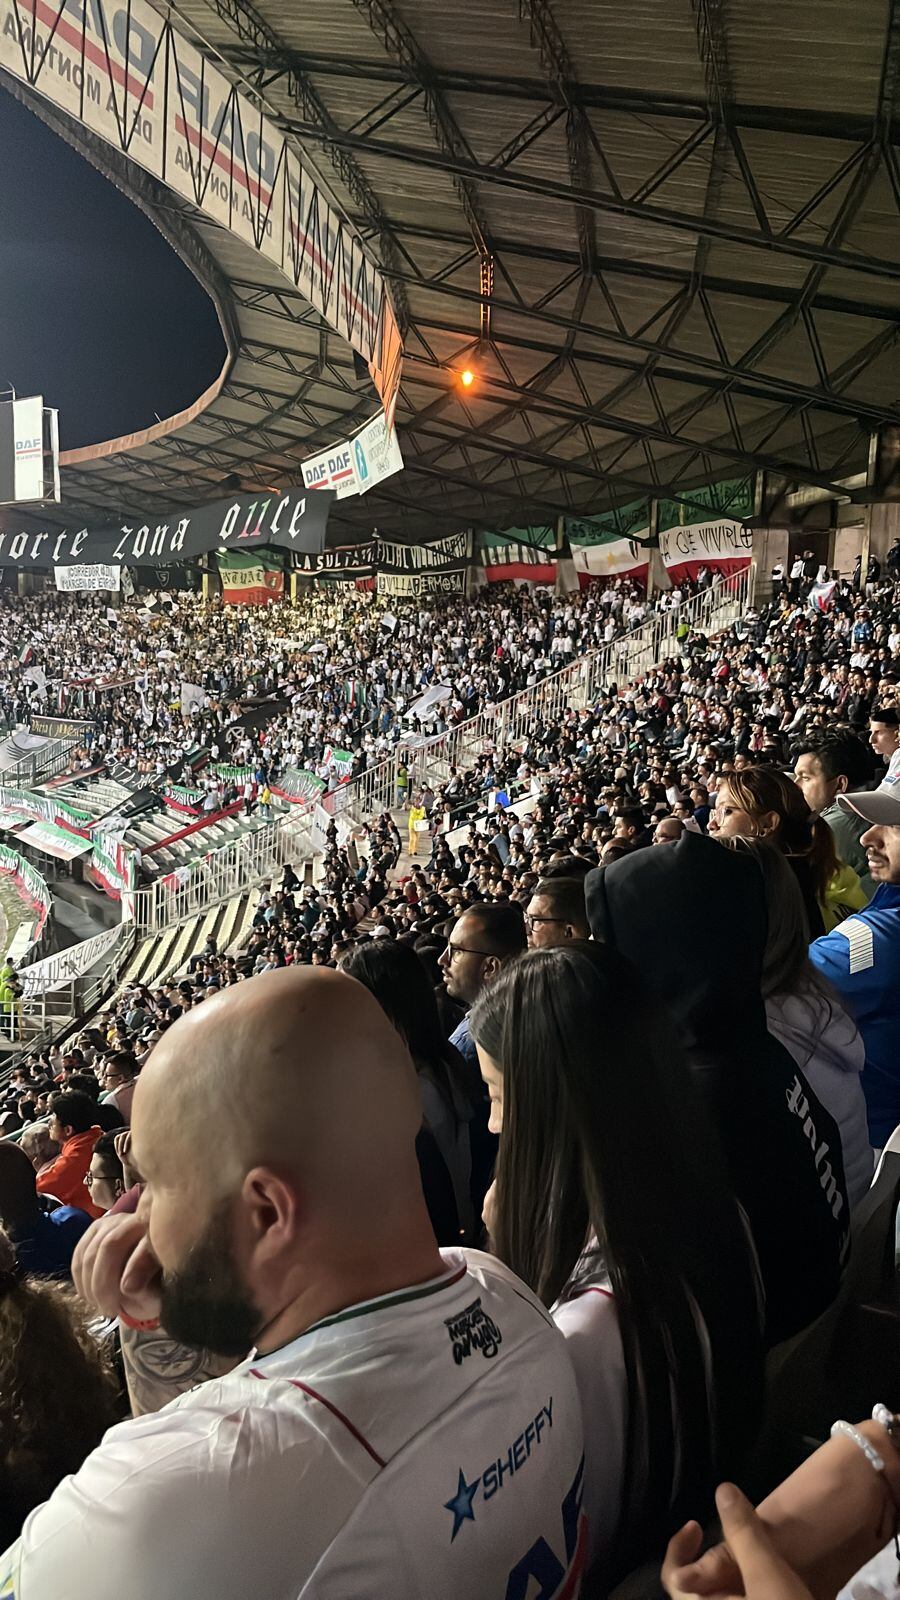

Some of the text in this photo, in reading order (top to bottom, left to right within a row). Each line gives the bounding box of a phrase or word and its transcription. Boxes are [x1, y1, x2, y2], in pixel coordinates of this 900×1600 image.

[16, 438, 41, 450] DAF
[305, 463, 326, 484] DAF
[328, 451, 350, 474] DAF
[112, 518, 191, 561] zona
[482, 1396, 553, 1501] SHEFFY
